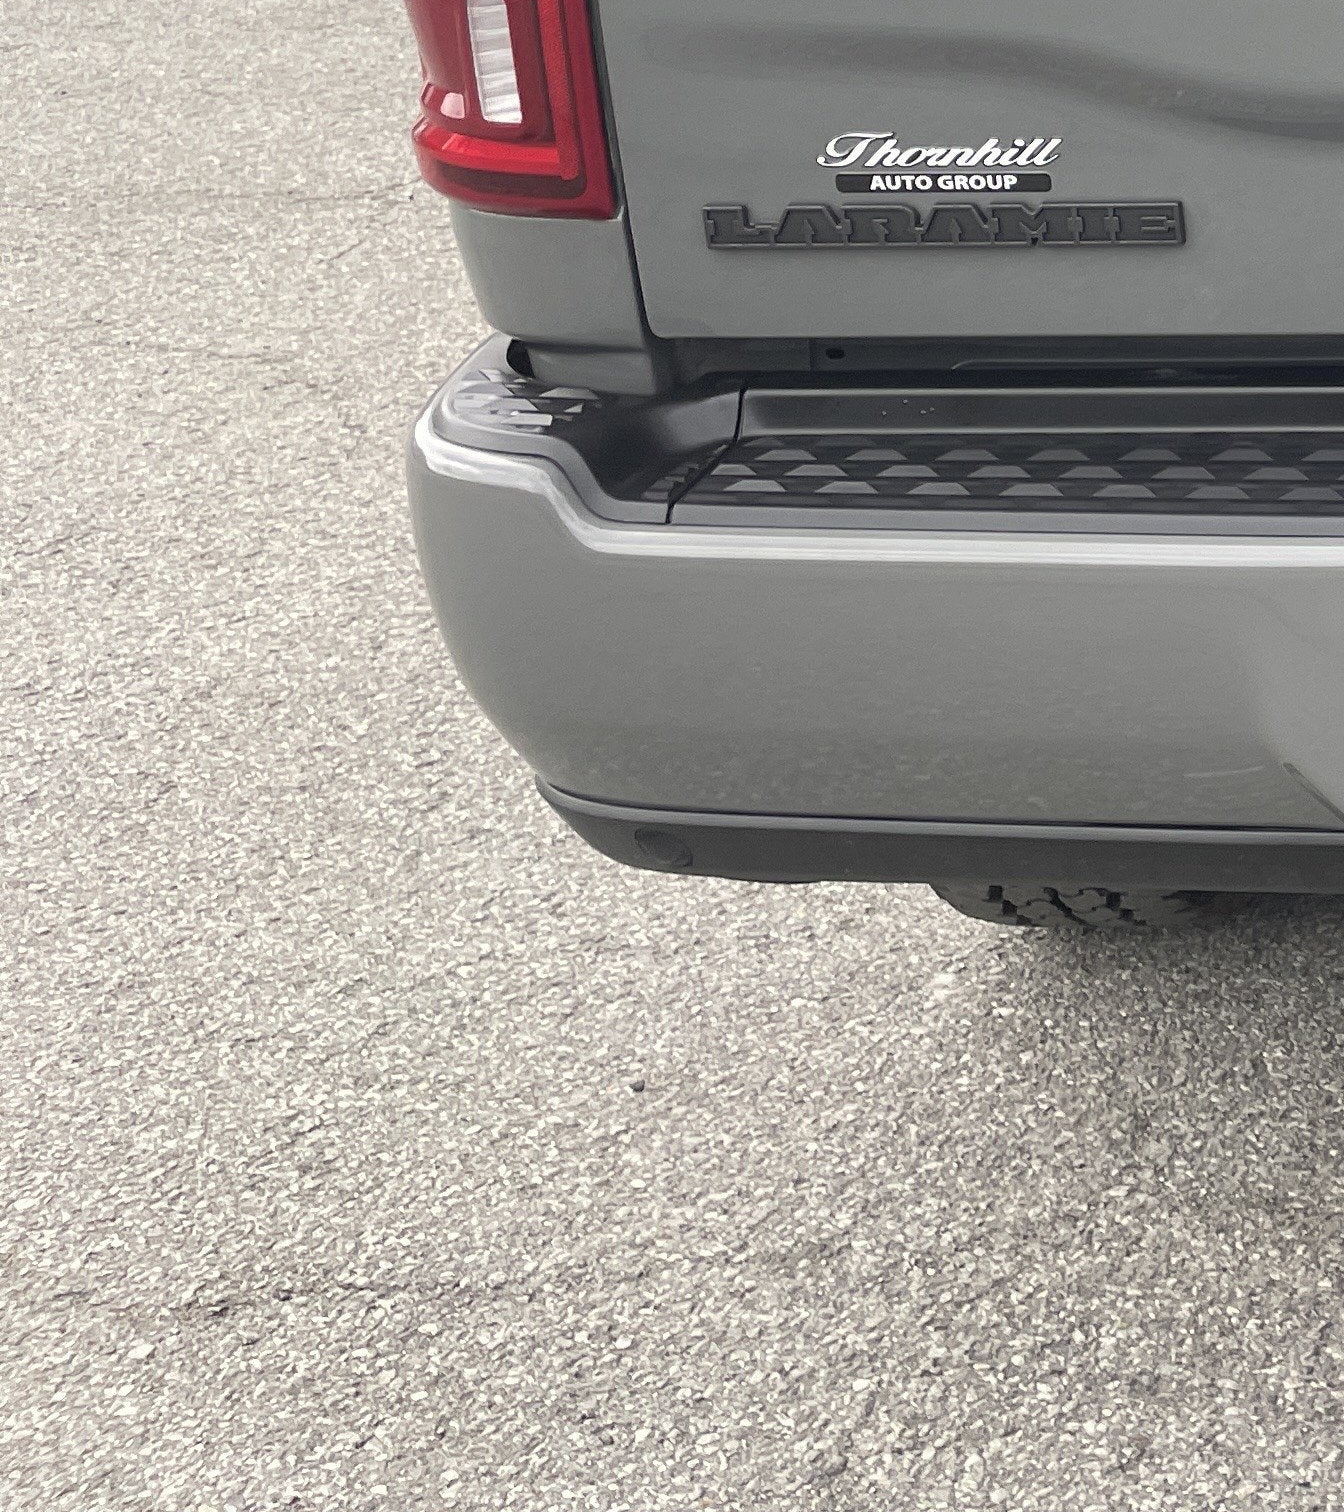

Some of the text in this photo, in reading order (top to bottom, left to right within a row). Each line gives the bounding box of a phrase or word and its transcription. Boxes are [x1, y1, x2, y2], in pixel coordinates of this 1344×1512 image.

[816, 130, 1063, 168] Thornhill
[869, 173, 1019, 191] AUTO GROUP
[702, 199, 1187, 249] LARAMIE
